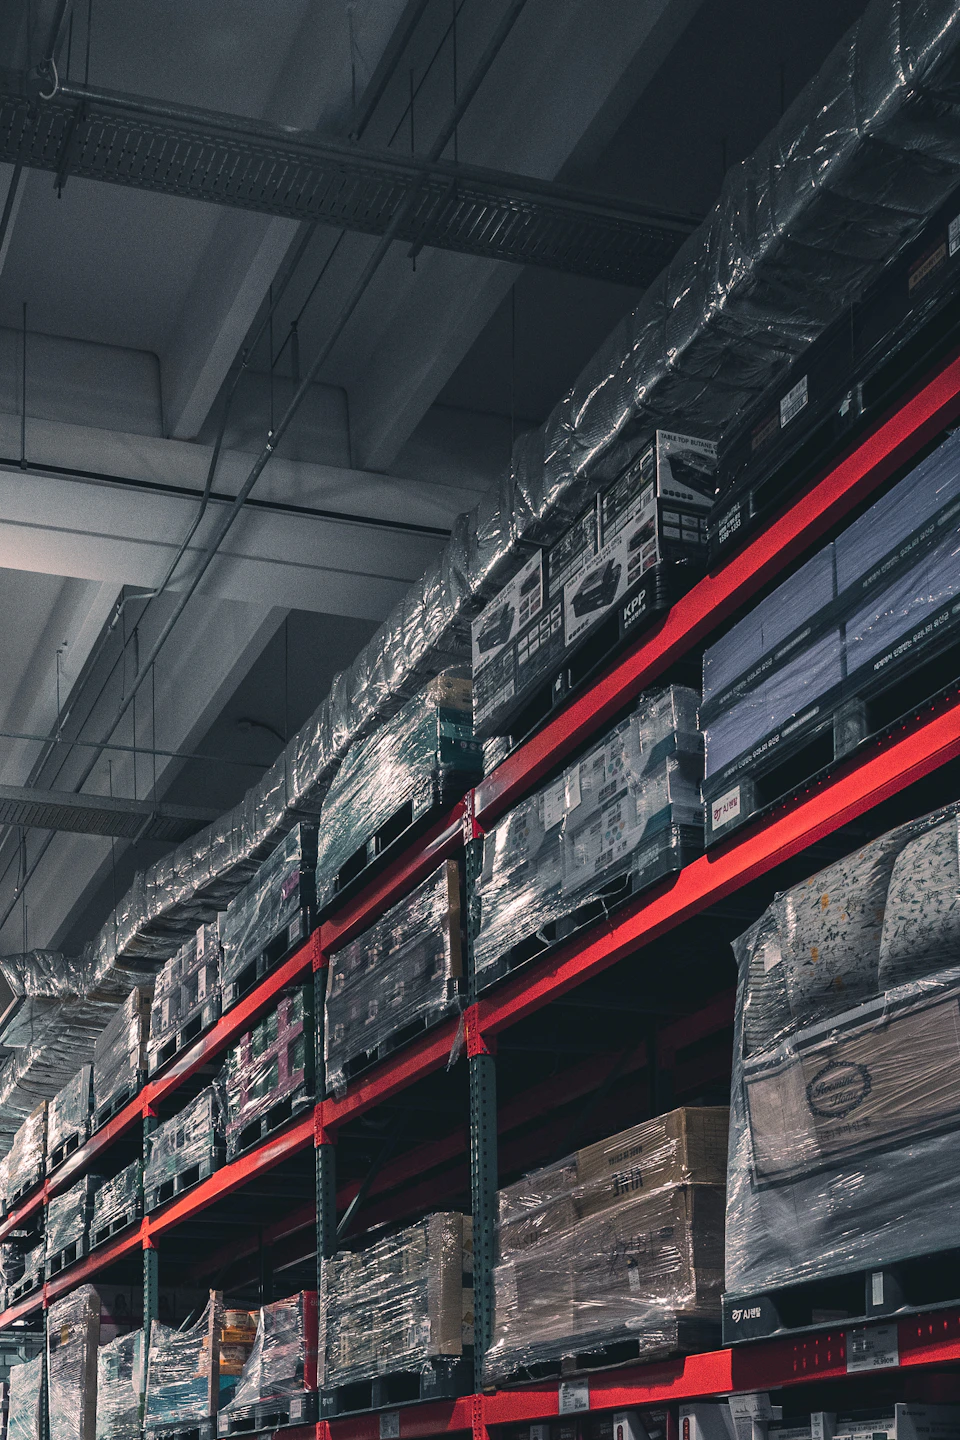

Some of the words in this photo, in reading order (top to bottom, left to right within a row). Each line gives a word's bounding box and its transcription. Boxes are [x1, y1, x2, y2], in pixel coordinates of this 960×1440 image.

[661, 433, 677, 442] TABLE
[691, 439, 712, 449] BUTANE
[623, 589, 646, 620] KPP
